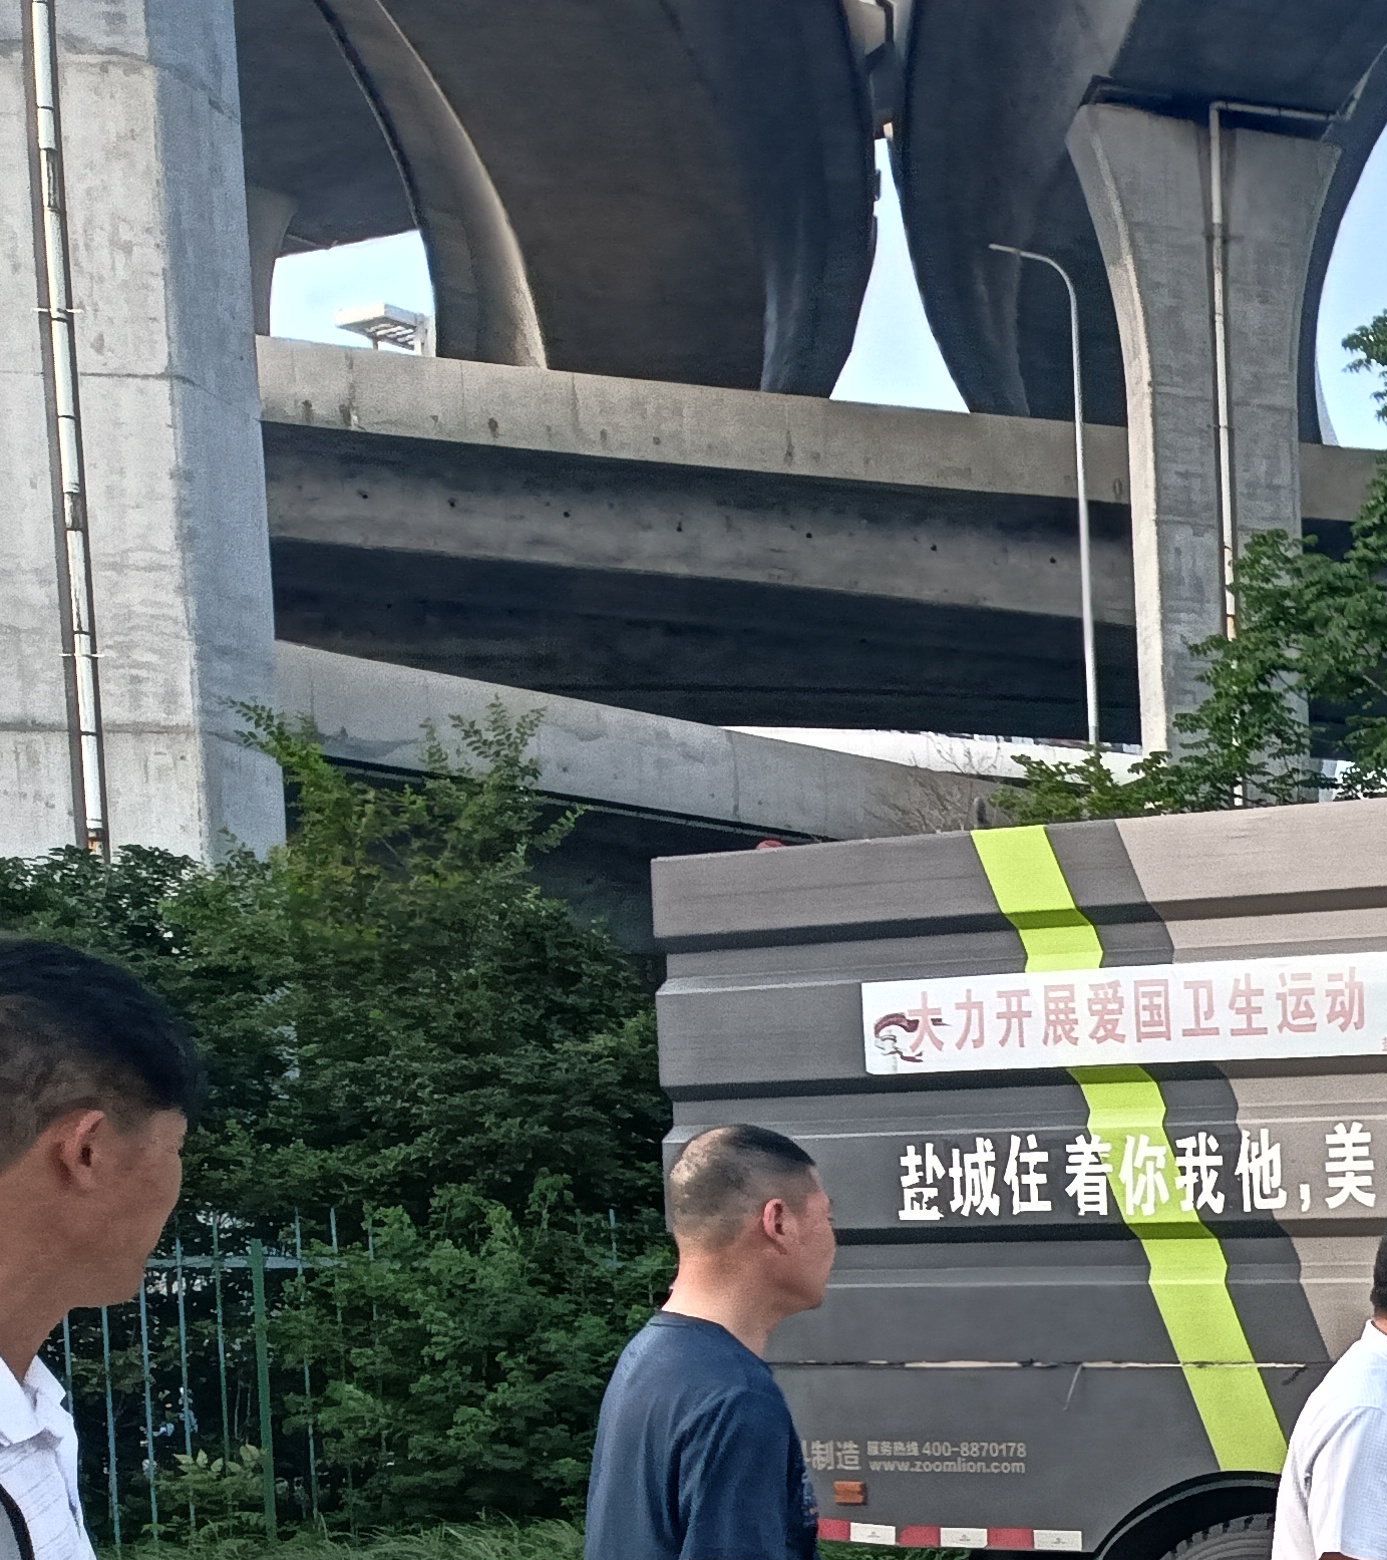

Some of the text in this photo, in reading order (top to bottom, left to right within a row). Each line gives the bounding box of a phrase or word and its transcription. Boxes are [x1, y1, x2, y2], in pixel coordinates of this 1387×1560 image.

[907, 966, 1367, 1052] 大力开展爱国卫生运动
[922, 1442, 1027, 1457] 400-8870178
[868, 1457, 1026, 1474] www.zoomlion.com
